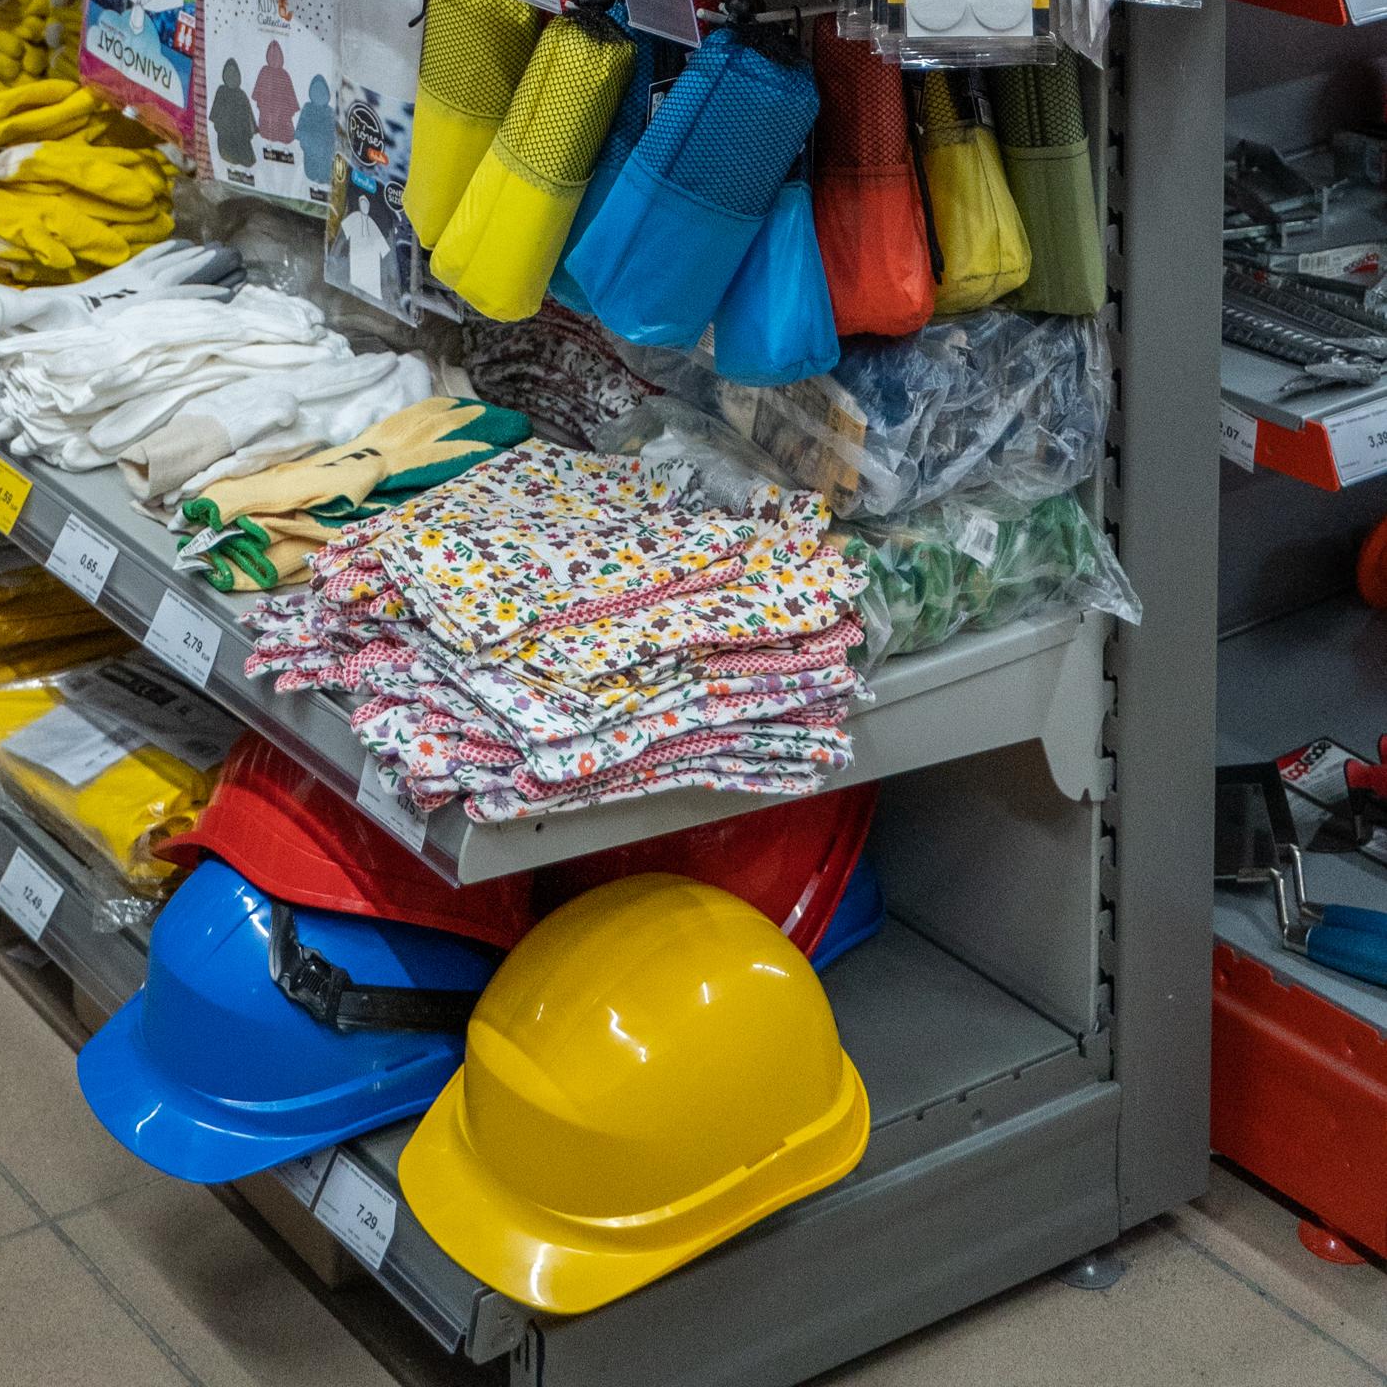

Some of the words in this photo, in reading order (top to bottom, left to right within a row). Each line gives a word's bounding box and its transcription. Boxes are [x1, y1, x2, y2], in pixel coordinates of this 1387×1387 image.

[97, 29, 174, 90] RAINCOAT
[79, 552, 99, 574] 0,65
[182, 630, 204, 655] 2,79
[355, 1203, 379, 1230] 7,29
